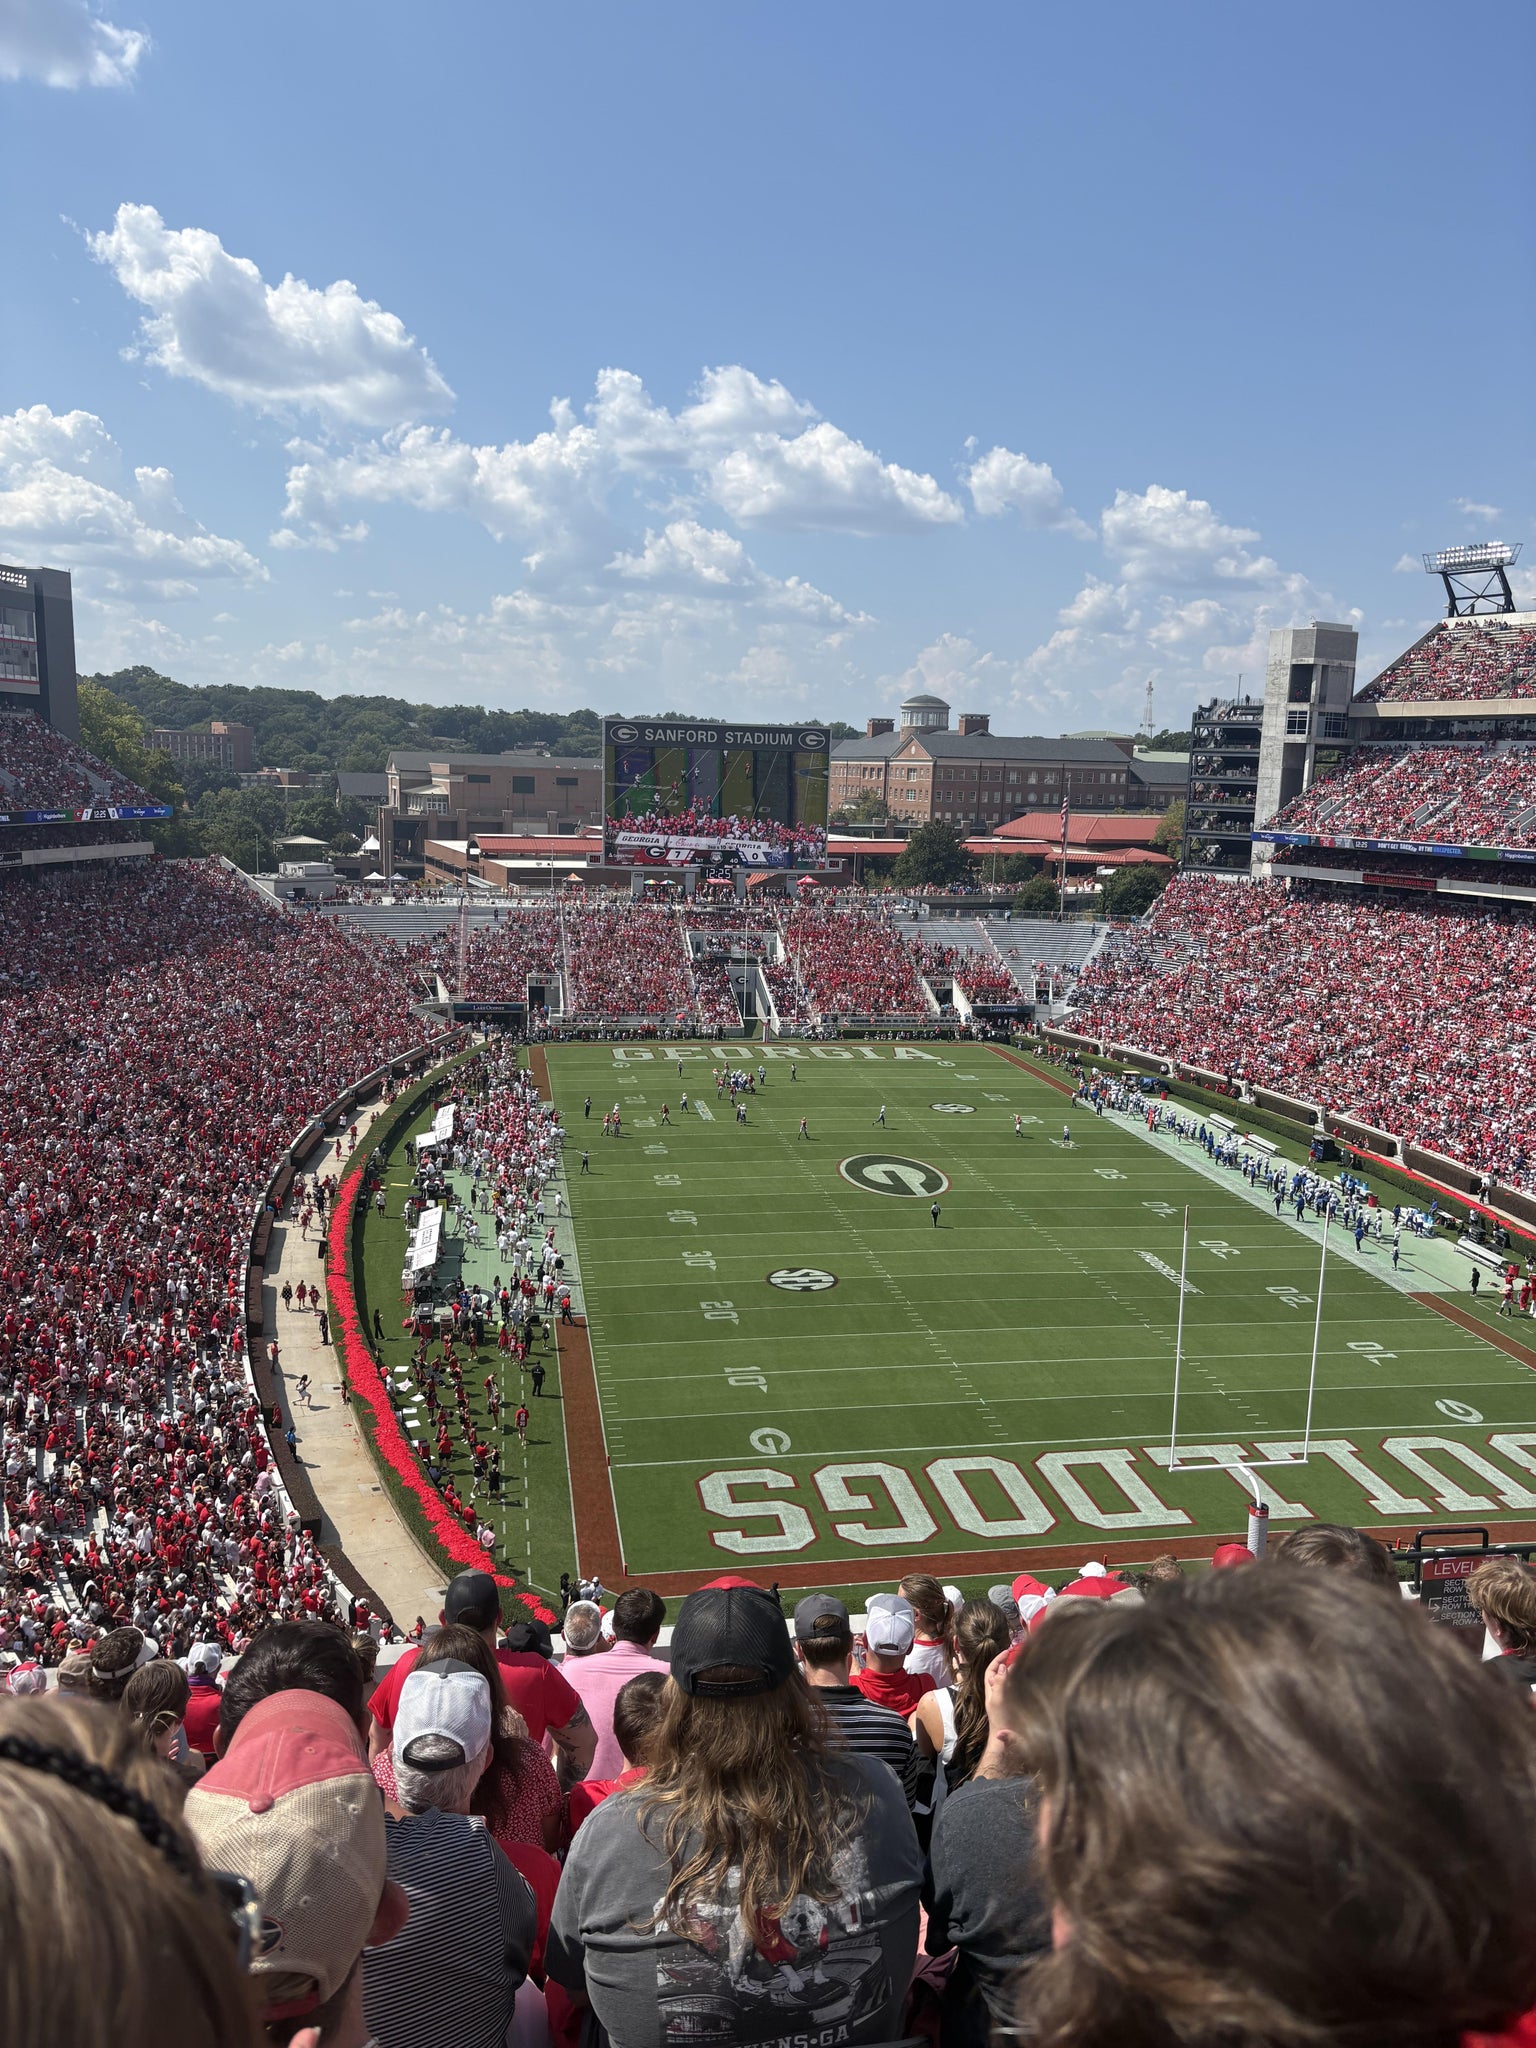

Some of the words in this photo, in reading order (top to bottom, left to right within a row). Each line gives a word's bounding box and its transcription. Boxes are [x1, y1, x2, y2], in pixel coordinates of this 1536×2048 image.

[645, 728, 718, 743] SANFORD
[725, 731, 793, 745] STADIUM
[622, 836, 660, 844] GEORGIA
[706, 868, 731, 878] 12:25
[612, 1046, 942, 1060] GEORGIA
[653, 1174, 682, 1186] 50
[839, 1153, 949, 1198] G
[666, 1209, 698, 1223] 40
[1198, 1240, 1241, 1256] 30
[682, 1250, 716, 1266] 30
[1265, 1286, 1314, 1304] 20
[700, 1300, 739, 1320] 20
[1346, 1341, 1399, 1362] 10
[723, 1365, 768, 1387] 10
[1434, 1399, 1484, 1423] G
[749, 1427, 792, 1455] G
[1434, 1561, 1476, 1575] LEVEL
[1443, 1586, 1463, 1594] ROW
[1441, 1603, 1461, 1611] ROW
[1441, 1611, 1475, 1620] SECTION
